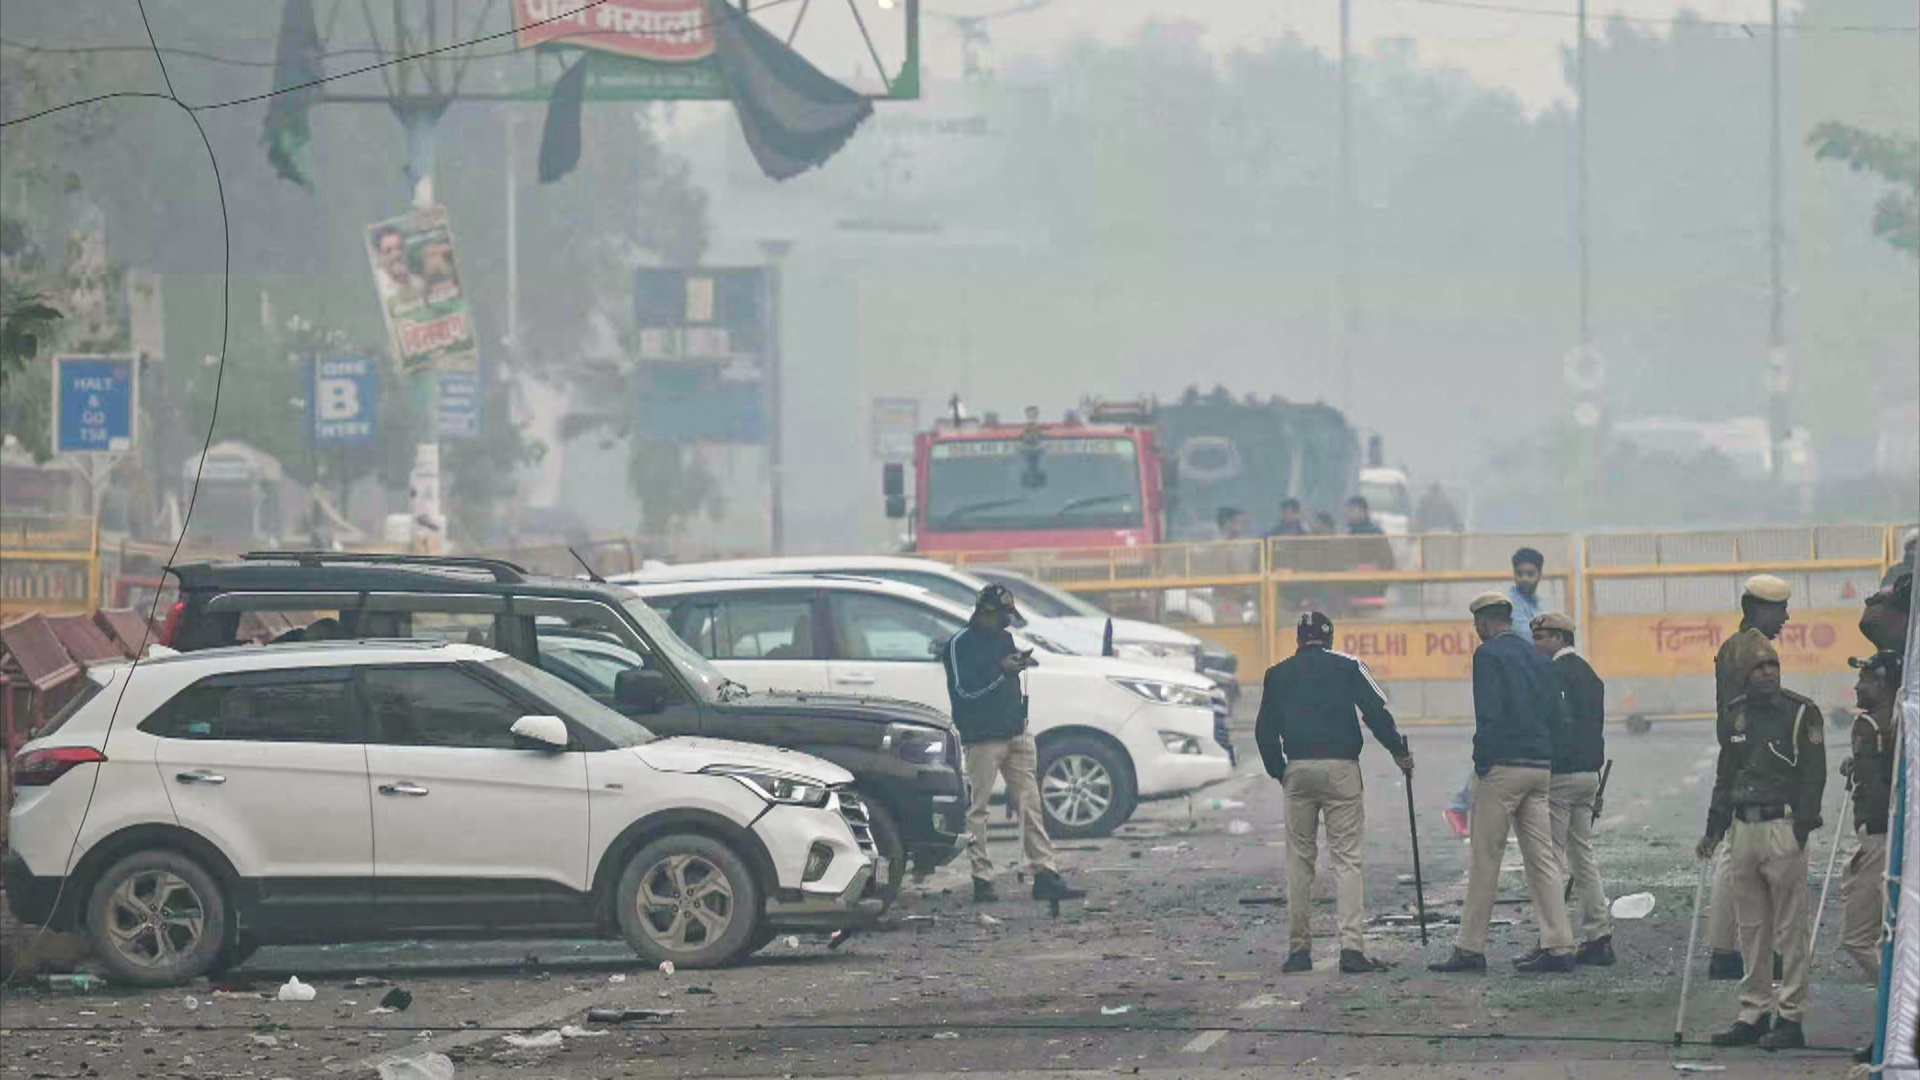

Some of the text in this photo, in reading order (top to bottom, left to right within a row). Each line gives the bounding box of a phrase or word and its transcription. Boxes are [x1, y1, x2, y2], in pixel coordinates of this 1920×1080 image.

[596, 5, 702, 44] मसाला
[73, 378, 113, 391] HALT
[317, 379, 359, 420] B
[83, 411, 106, 424] GO
[1343, 632, 1476, 656] DELHI POLI
